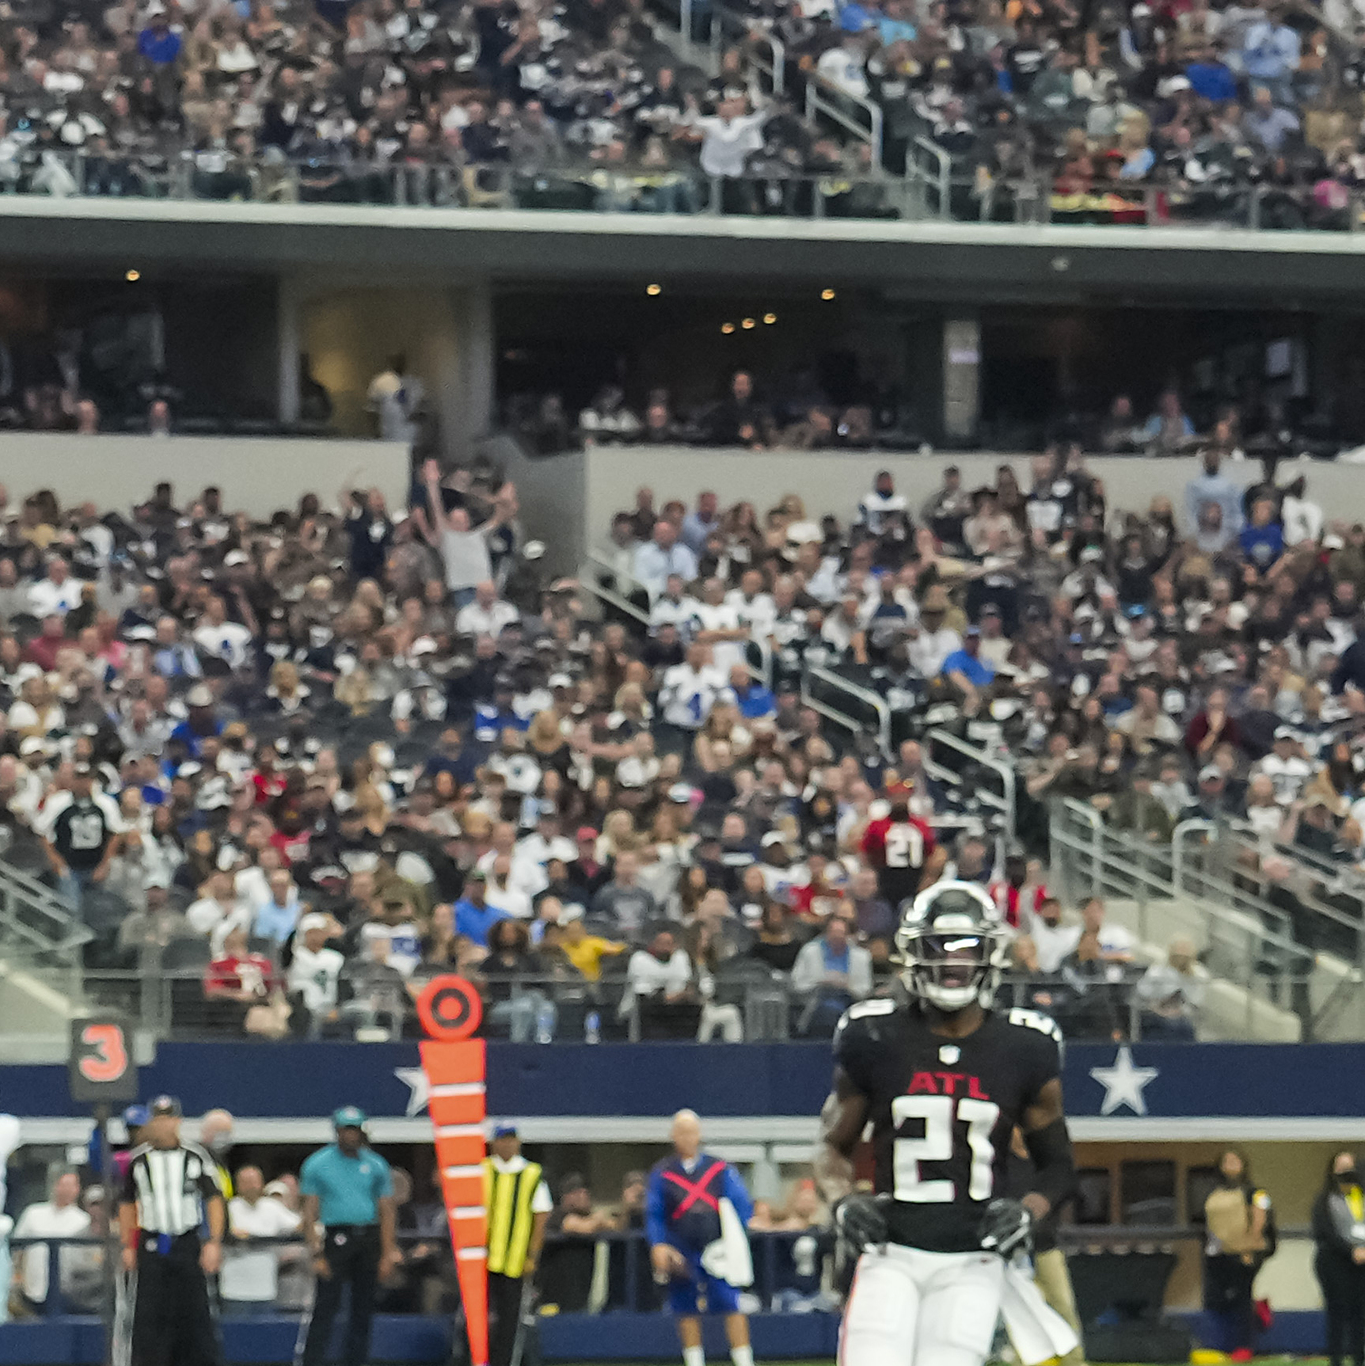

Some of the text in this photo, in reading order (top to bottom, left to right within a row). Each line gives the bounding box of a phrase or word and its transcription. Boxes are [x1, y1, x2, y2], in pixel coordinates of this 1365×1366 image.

[885, 824, 924, 869] 21
[80, 1024, 127, 1081] 3
[907, 1072, 989, 1100] ATL
[892, 1095, 1000, 1203] 21
